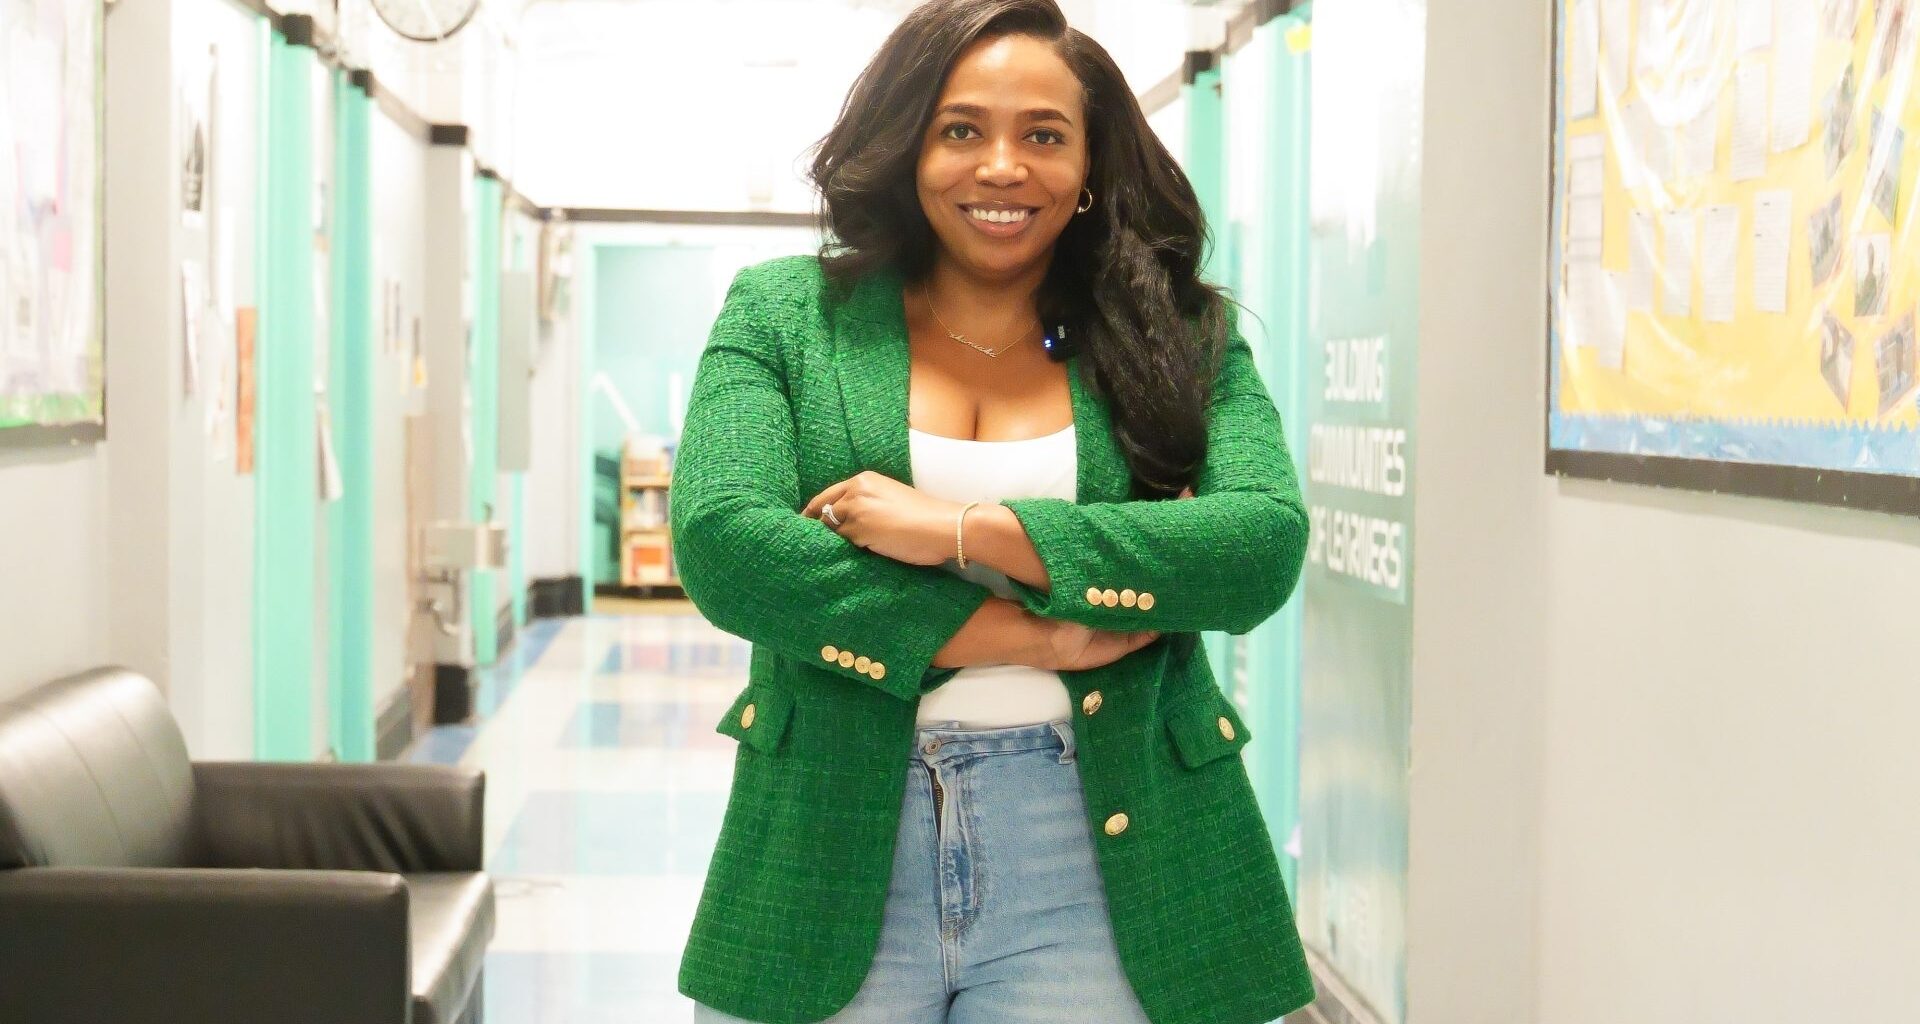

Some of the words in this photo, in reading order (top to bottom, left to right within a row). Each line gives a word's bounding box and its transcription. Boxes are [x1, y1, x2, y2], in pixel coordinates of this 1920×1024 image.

[1324, 337, 1384, 403] BUILDING
[1310, 424, 1406, 497] COMMUNITIES
[1309, 505, 1326, 564] OF
[1326, 508, 1401, 589] LEARNERS
